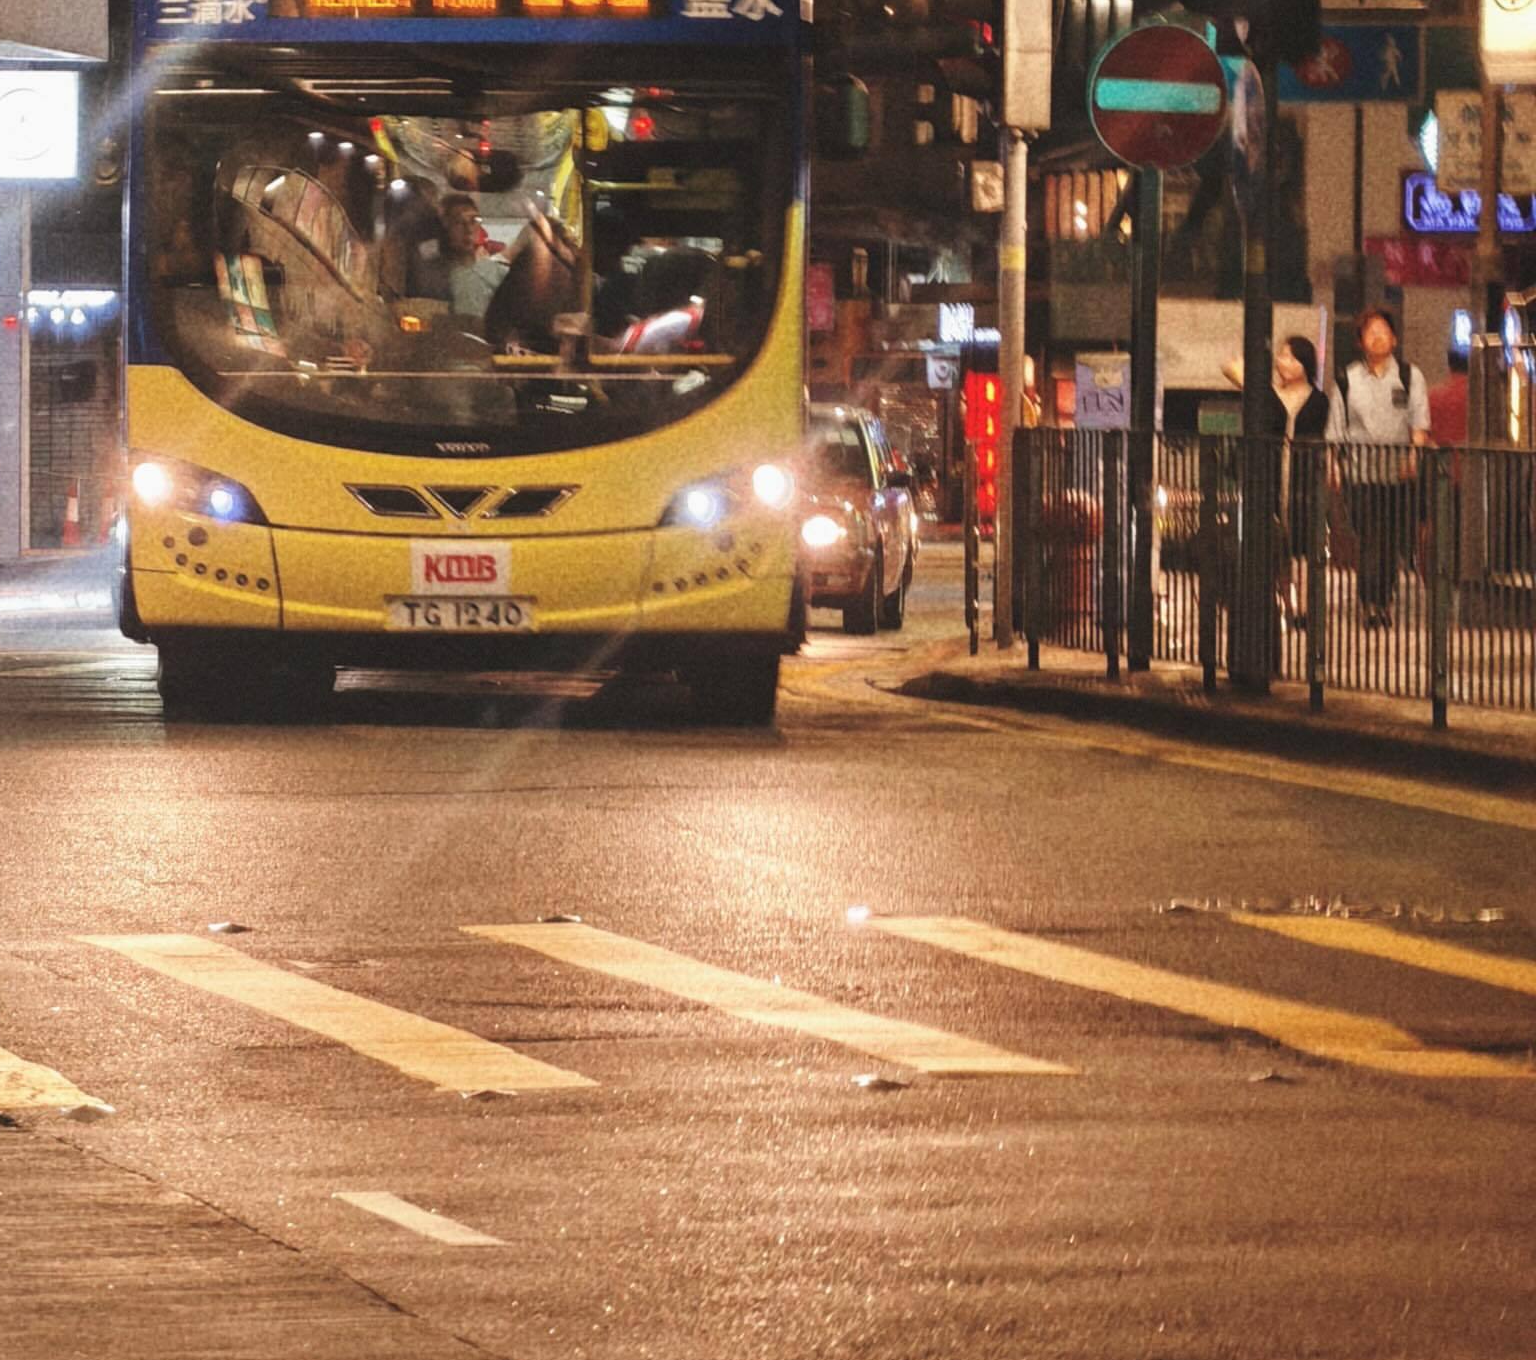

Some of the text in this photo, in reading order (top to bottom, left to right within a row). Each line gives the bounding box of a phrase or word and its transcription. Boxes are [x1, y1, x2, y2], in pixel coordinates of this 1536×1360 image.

[424, 554, 498, 583] KMB
[404, 601, 523, 626] TG 1240
